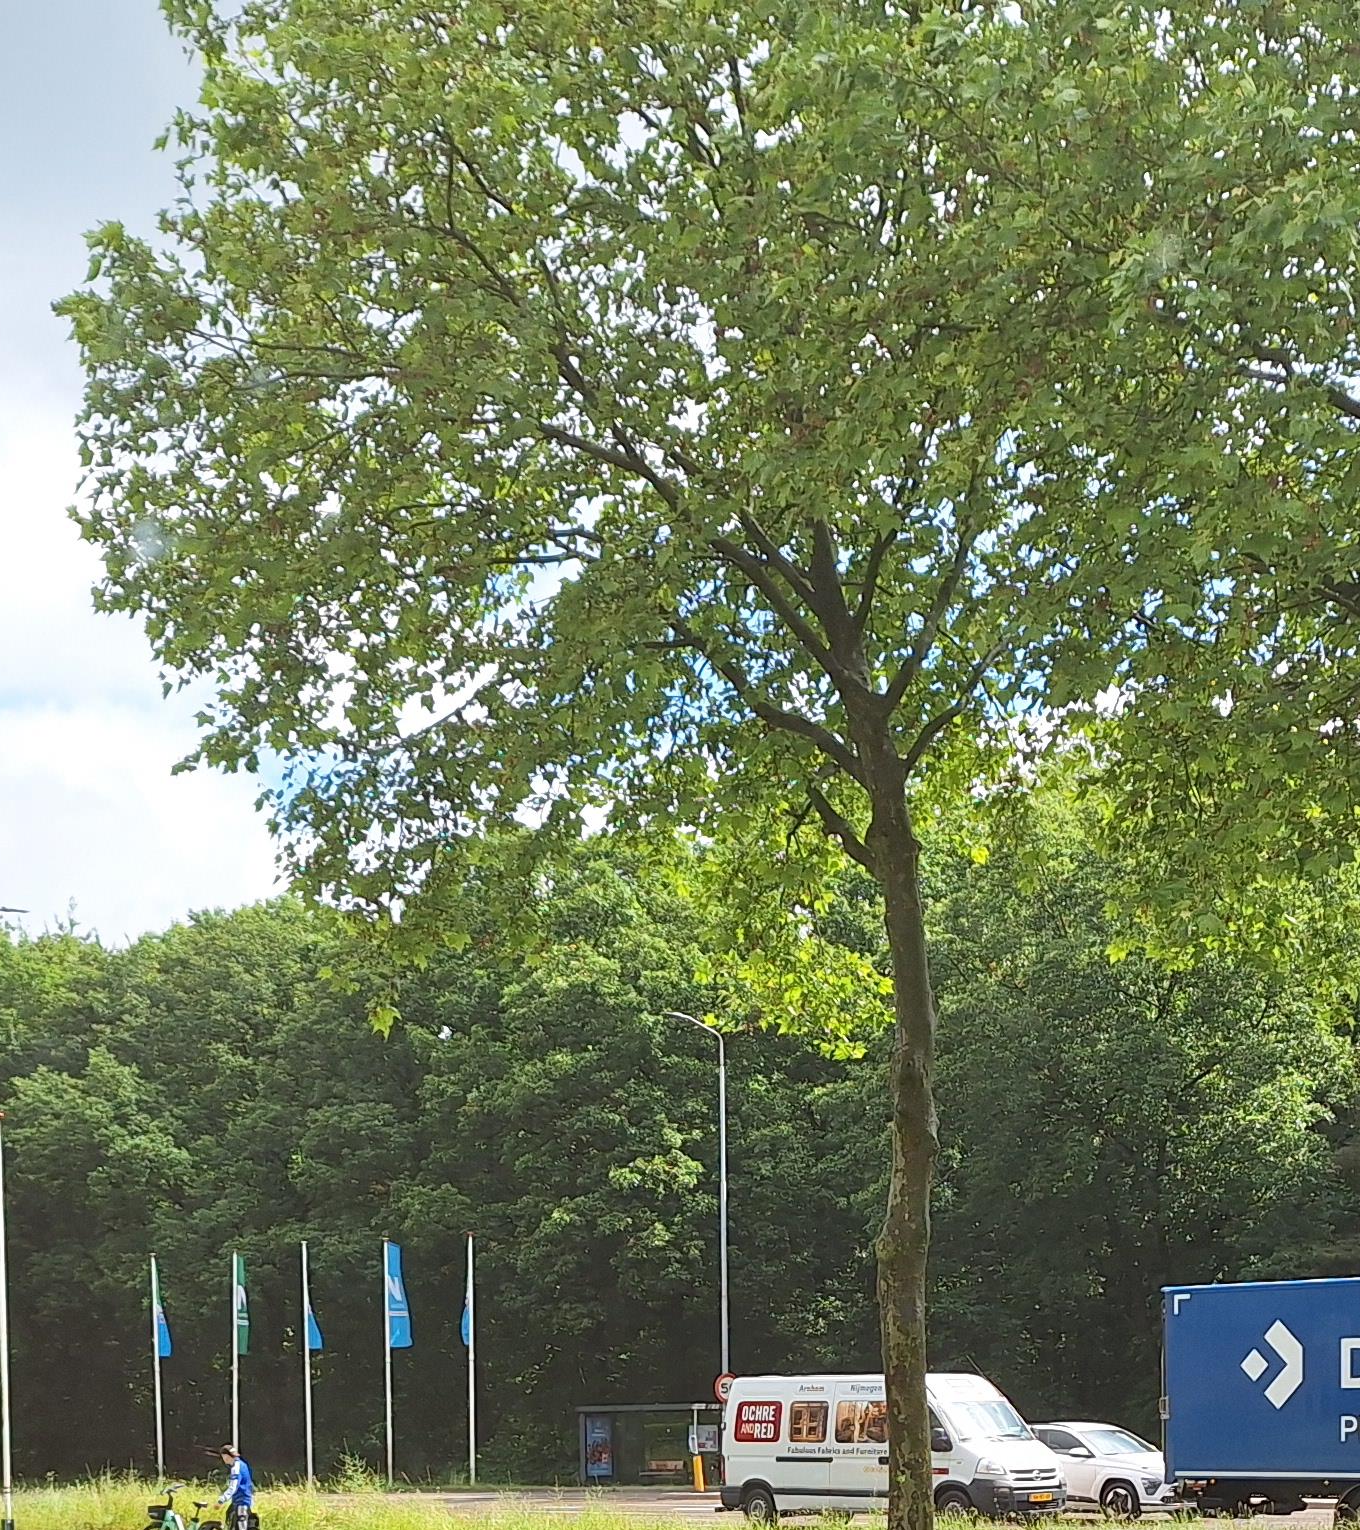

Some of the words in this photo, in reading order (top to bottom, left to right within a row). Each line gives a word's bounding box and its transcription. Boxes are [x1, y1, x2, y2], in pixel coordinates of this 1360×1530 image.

[741, 1405, 777, 1421] OCHRE
[740, 1424, 754, 1435] AND
[753, 1422, 775, 1439] RED
[842, 1447, 855, 1455] and
[856, 1447, 888, 1456] Furniture
